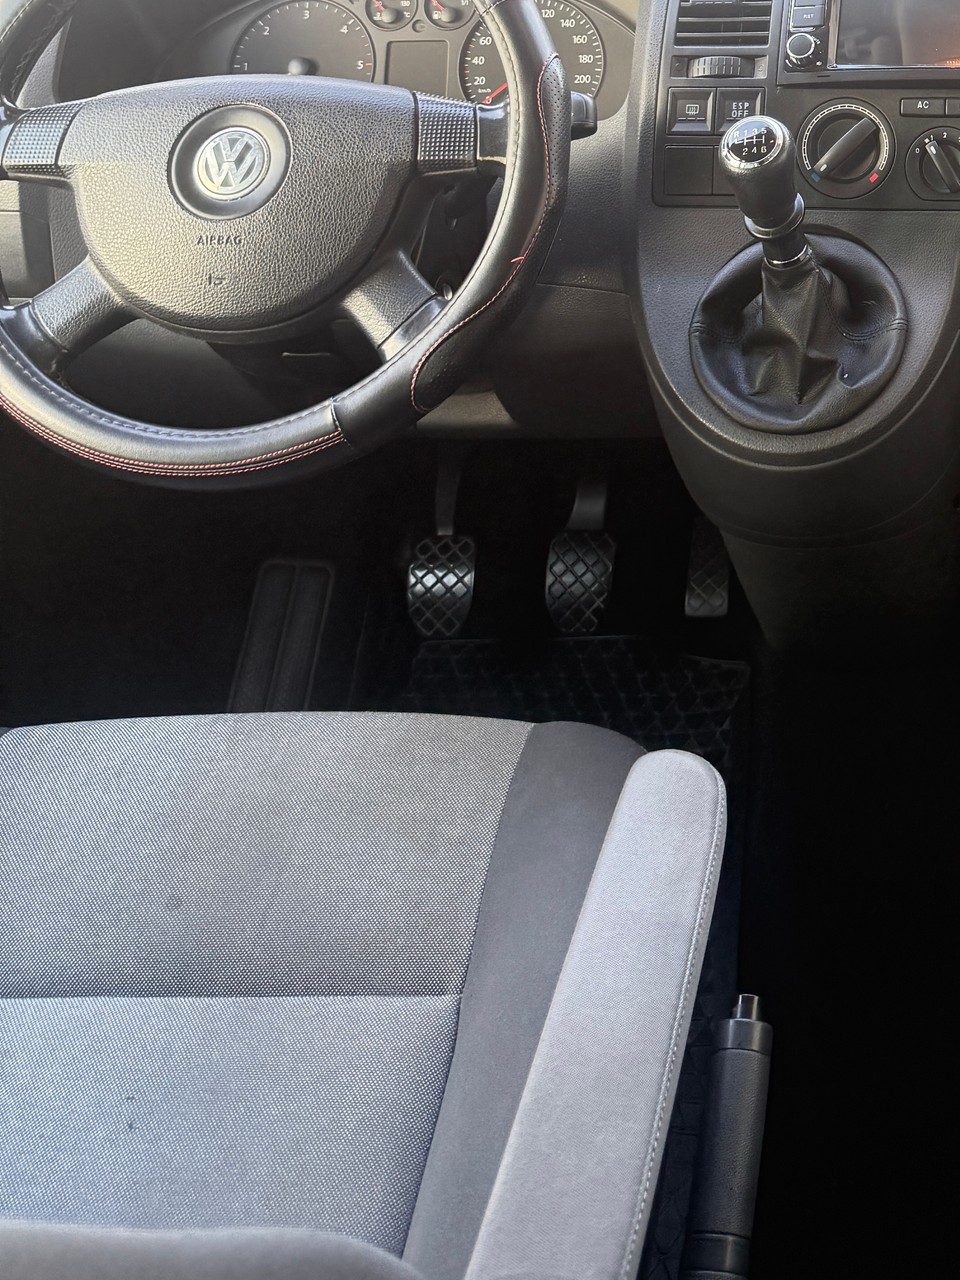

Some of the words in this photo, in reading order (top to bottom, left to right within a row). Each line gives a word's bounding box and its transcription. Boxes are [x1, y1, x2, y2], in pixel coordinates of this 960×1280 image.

[303, 10, 310, 19] 3
[541, 9, 555, 18] 120
[560, 19, 576, 28] 140
[263, 26, 270, 35] 2
[340, 25, 349, 34] 4
[479, 36, 492, 46] 60
[572, 35, 588, 44] 160
[471, 56, 485, 65] 40
[578, 54, 594, 64] 180
[243, 62, 248, 71] 1
[356, 60, 364, 70] 5
[474, 76, 486, 85] 20
[574, 74, 591, 84] 200
[732, 102, 750, 110] ESP
[916, 100, 930, 109] AC
[731, 110, 749, 118] OFF
[733, 130, 740, 138] R
[742, 147, 749, 155] 2
[751, 146, 757, 154] 4
[760, 145, 767, 153] 6
[196, 235, 243, 246] AIRBAG
